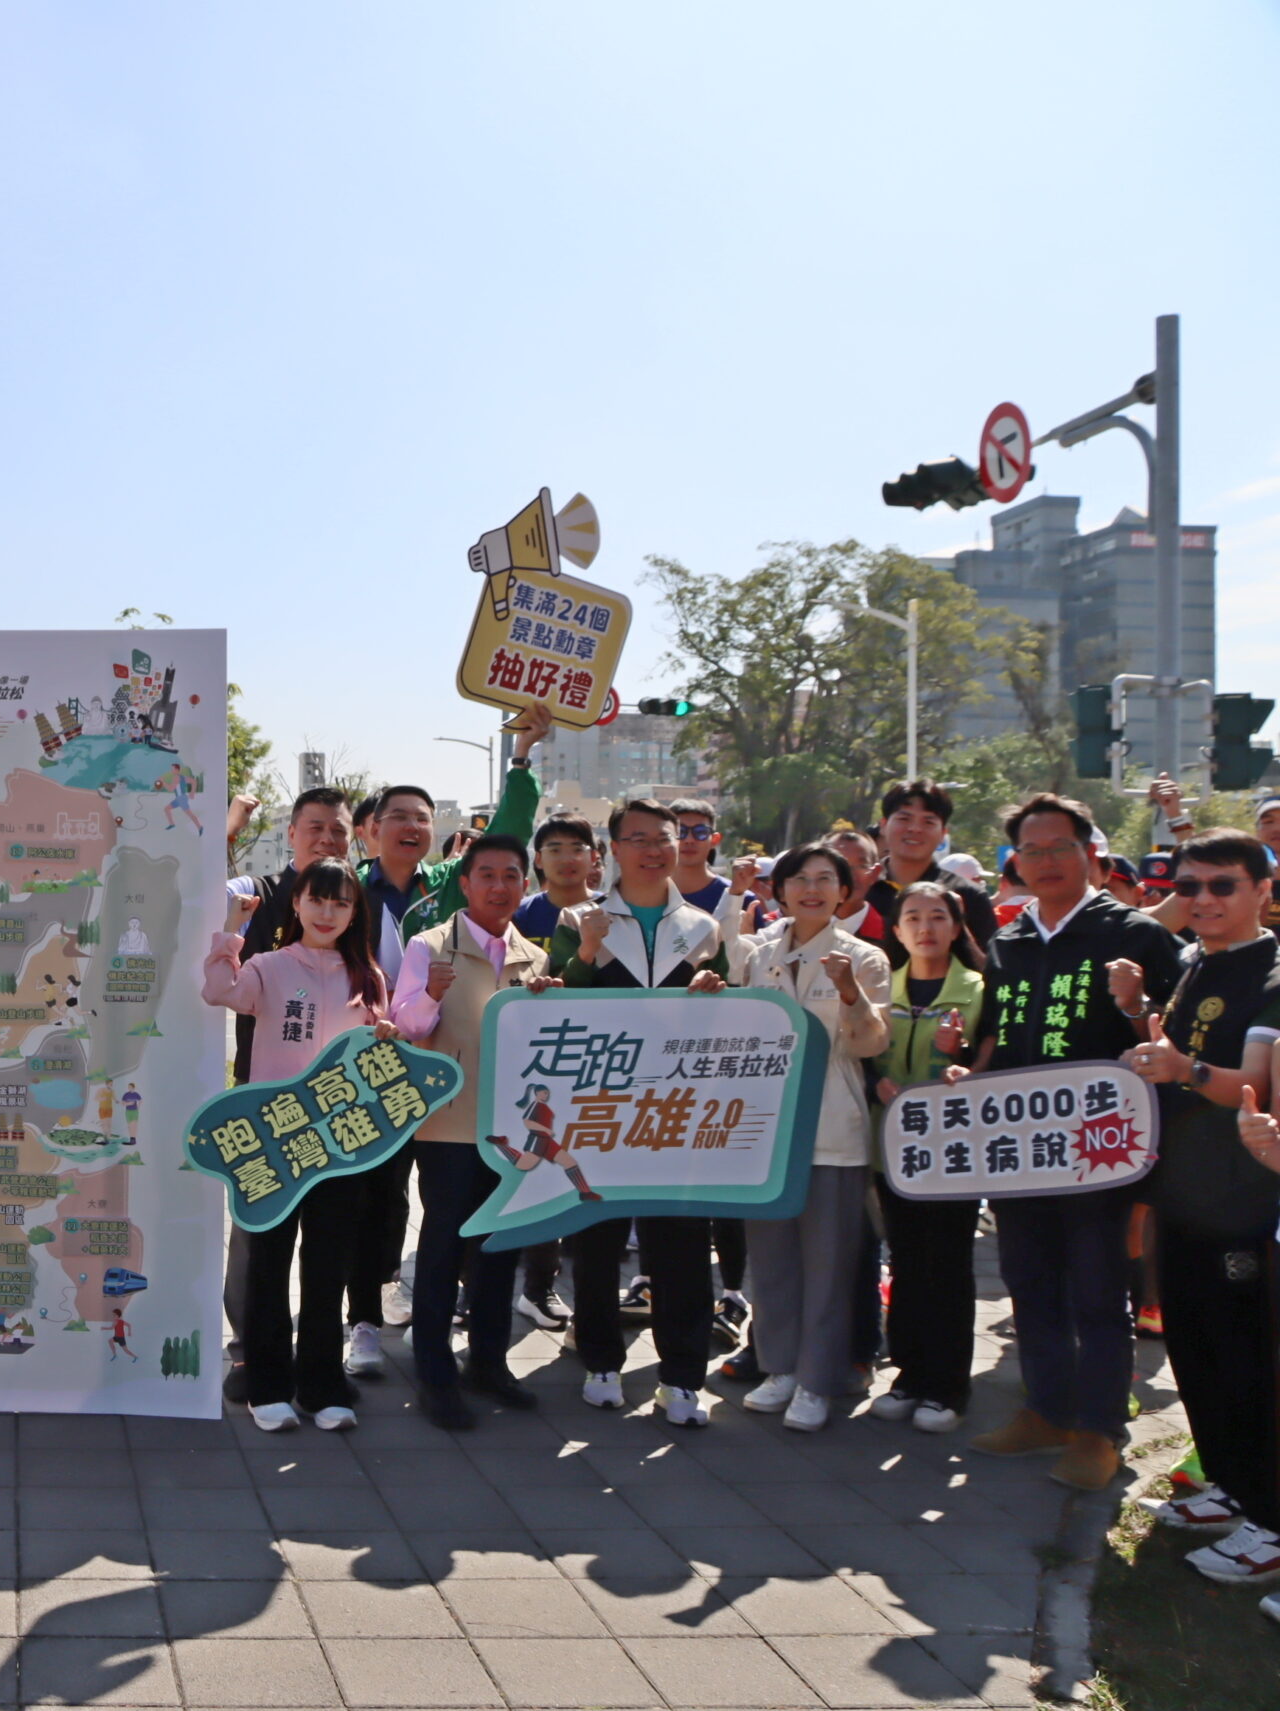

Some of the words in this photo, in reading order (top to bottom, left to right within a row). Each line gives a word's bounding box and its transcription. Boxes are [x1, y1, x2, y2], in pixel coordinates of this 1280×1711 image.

[513, 583, 612, 633] 集滿24個
[510, 616, 597, 661] 景點勳章
[487, 648, 594, 710] 抽好禮
[282, 1000, 305, 1043] 黃捷
[305, 1002, 316, 1041] 立法委員
[662, 1034, 795, 1055] 規律運動就像一場
[520, 1018, 645, 1092] 走跑
[665, 1054, 789, 1081] 人生馬拉松
[210, 1042, 408, 1164] 跑遍高雄
[561, 1087, 697, 1152] 高雄
[697, 1098, 745, 1130] 2.0
[900, 1080, 1120, 1136] 每天6000步
[233, 1081, 428, 1204] 臺灣雄勇
[692, 1130, 730, 1150] RUN
[901, 1131, 1070, 1178] 和生病說
[1083, 1124, 1129, 1152] NO!
